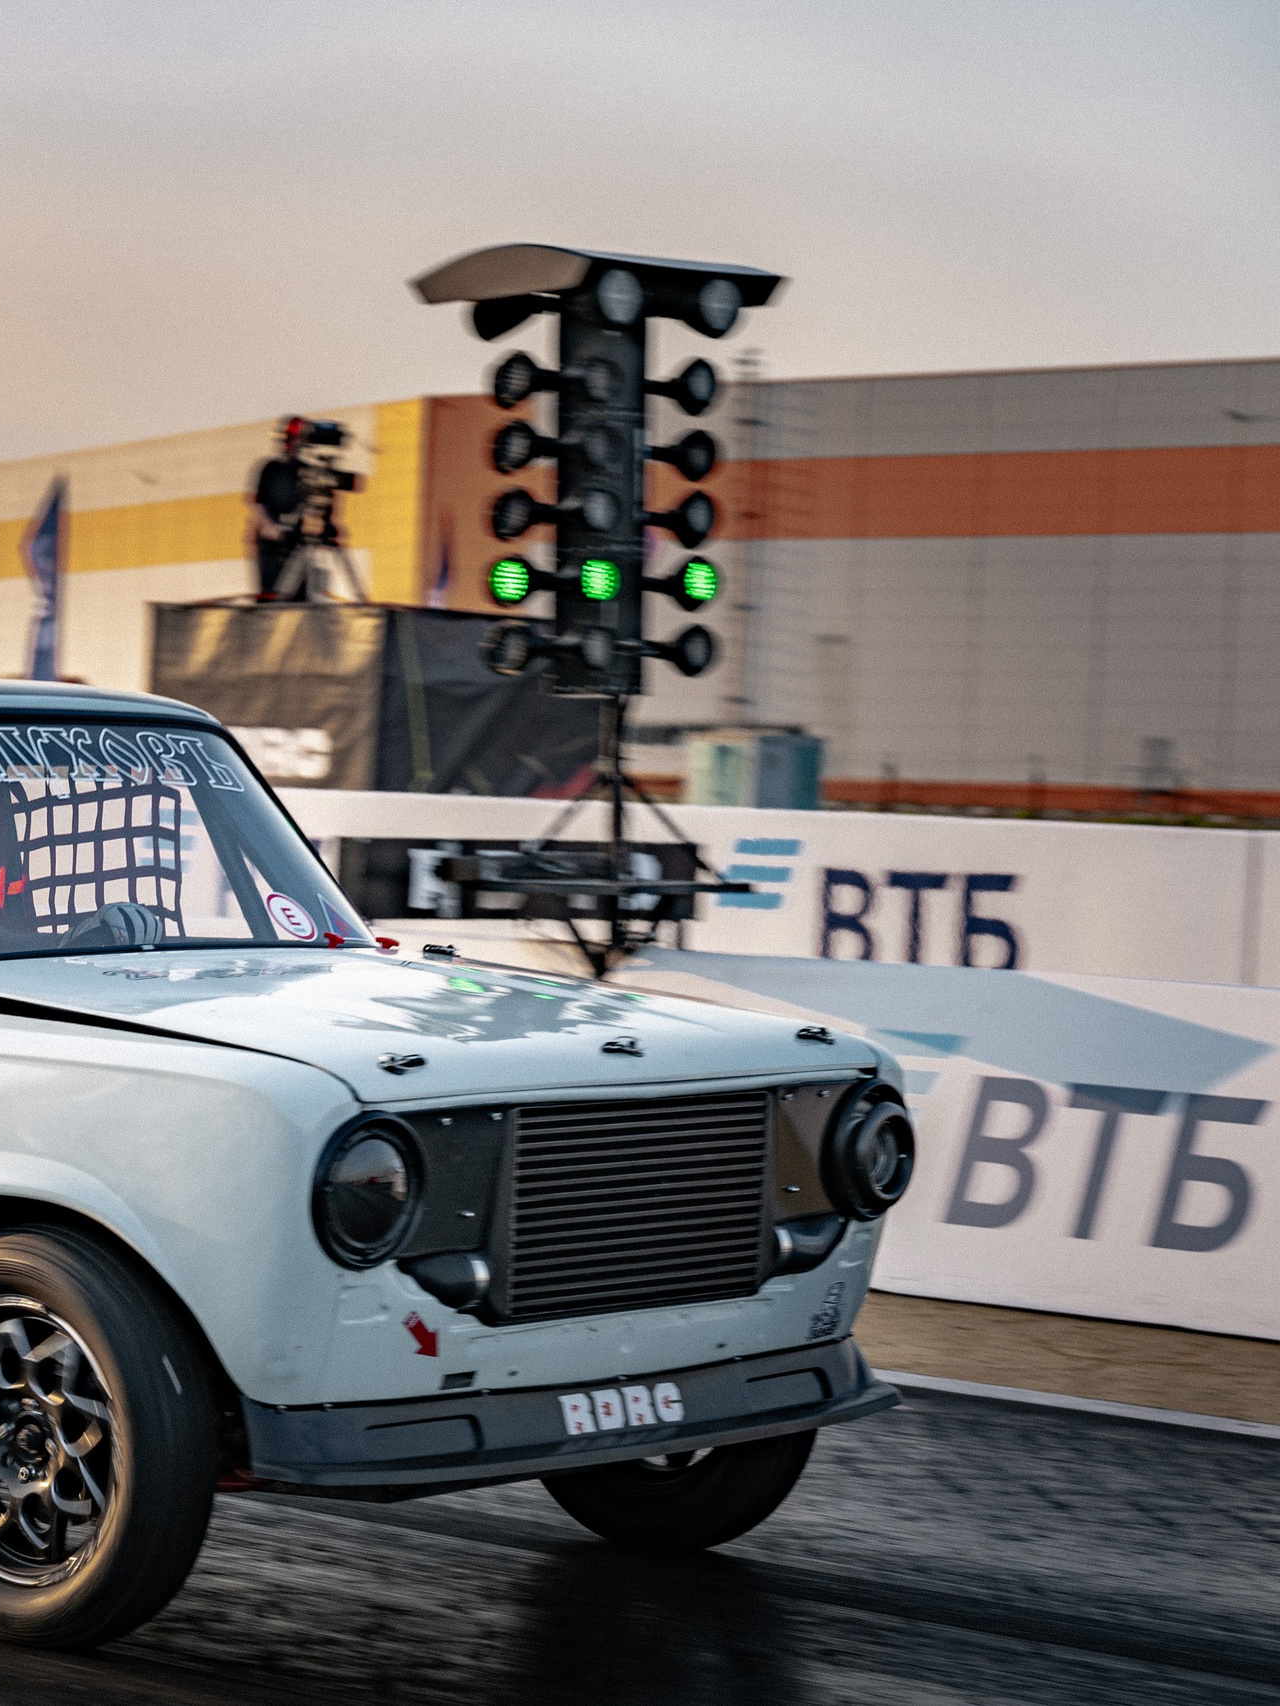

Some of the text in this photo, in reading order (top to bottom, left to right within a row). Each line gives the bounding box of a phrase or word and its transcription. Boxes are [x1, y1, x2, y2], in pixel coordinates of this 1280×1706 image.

[820, 867, 1021, 970] ВТБ
[940, 1074, 1273, 1253] ВТБ
[558, 1382, 685, 1435] RDRC
